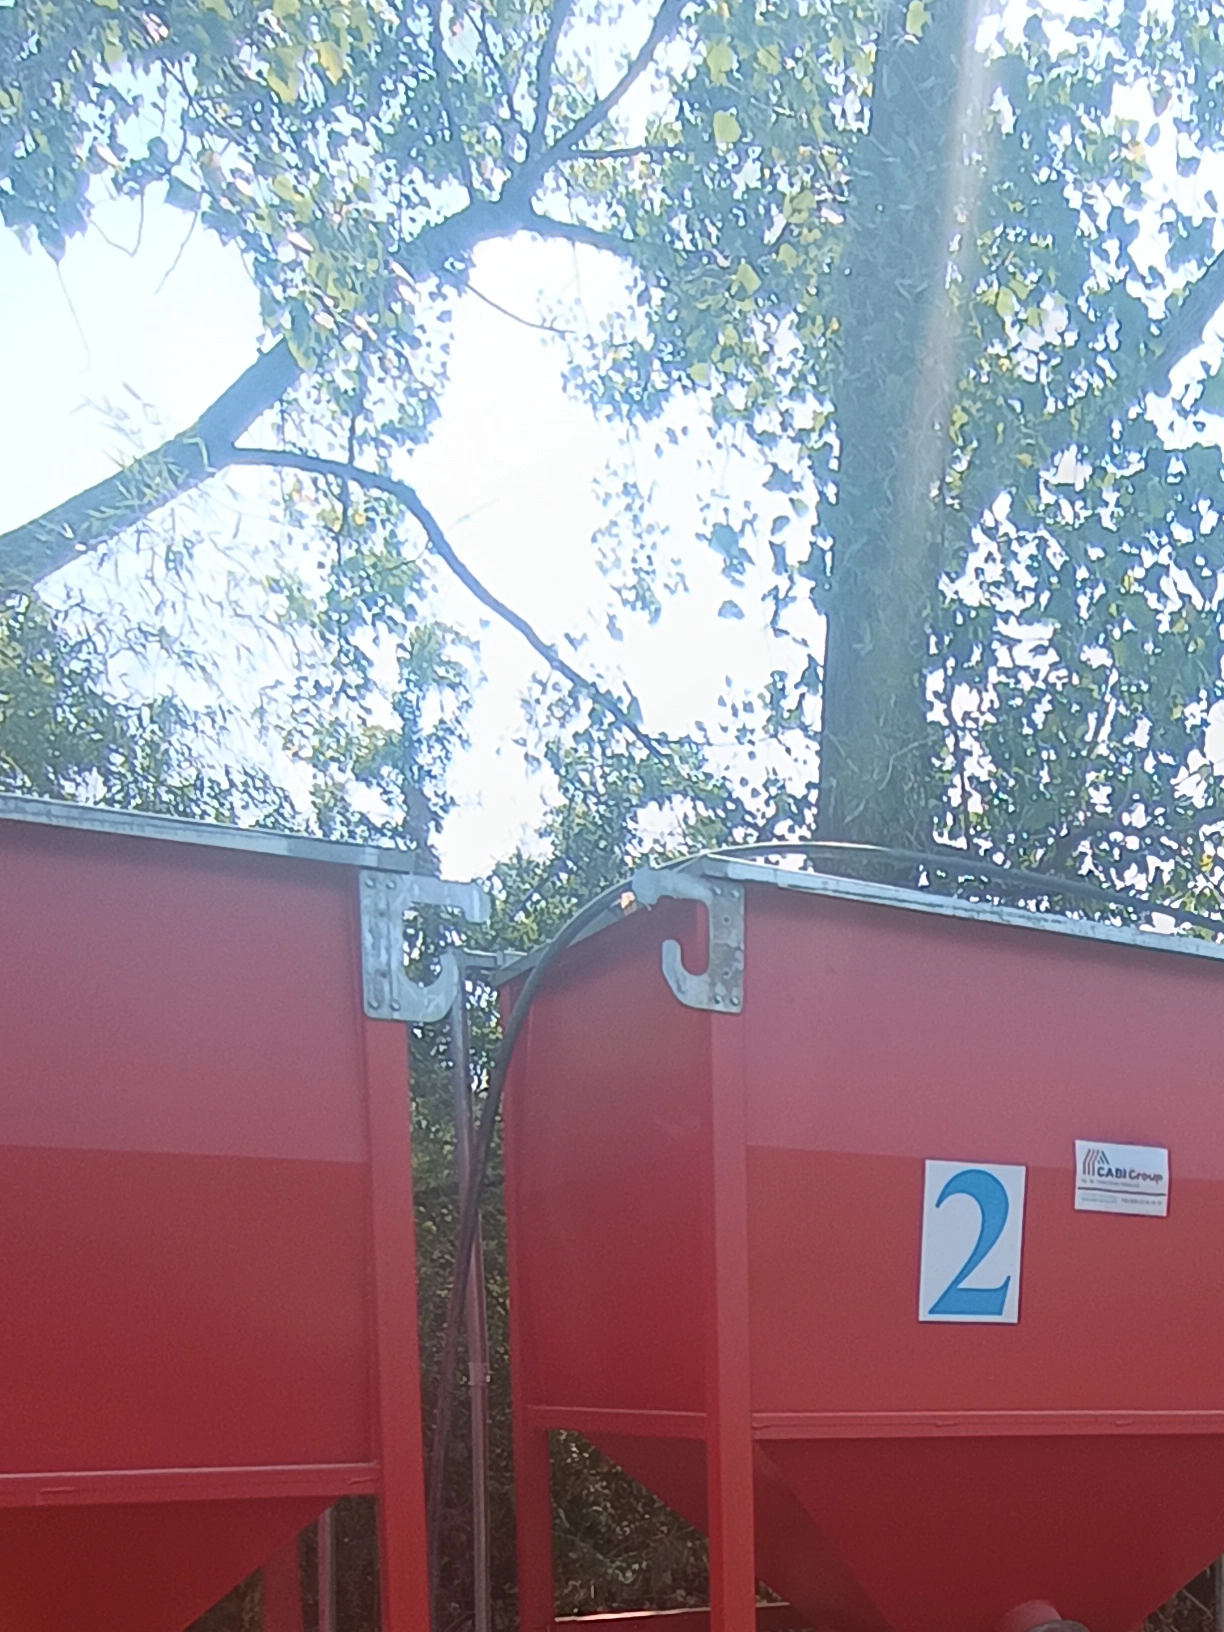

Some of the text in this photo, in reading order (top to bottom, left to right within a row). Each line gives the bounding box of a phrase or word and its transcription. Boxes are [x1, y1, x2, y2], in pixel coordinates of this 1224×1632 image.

[1097, 1166, 1127, 1179] CABI
[1128, 1169, 1163, 1185] Group
[928, 1168, 1011, 1316] 2
